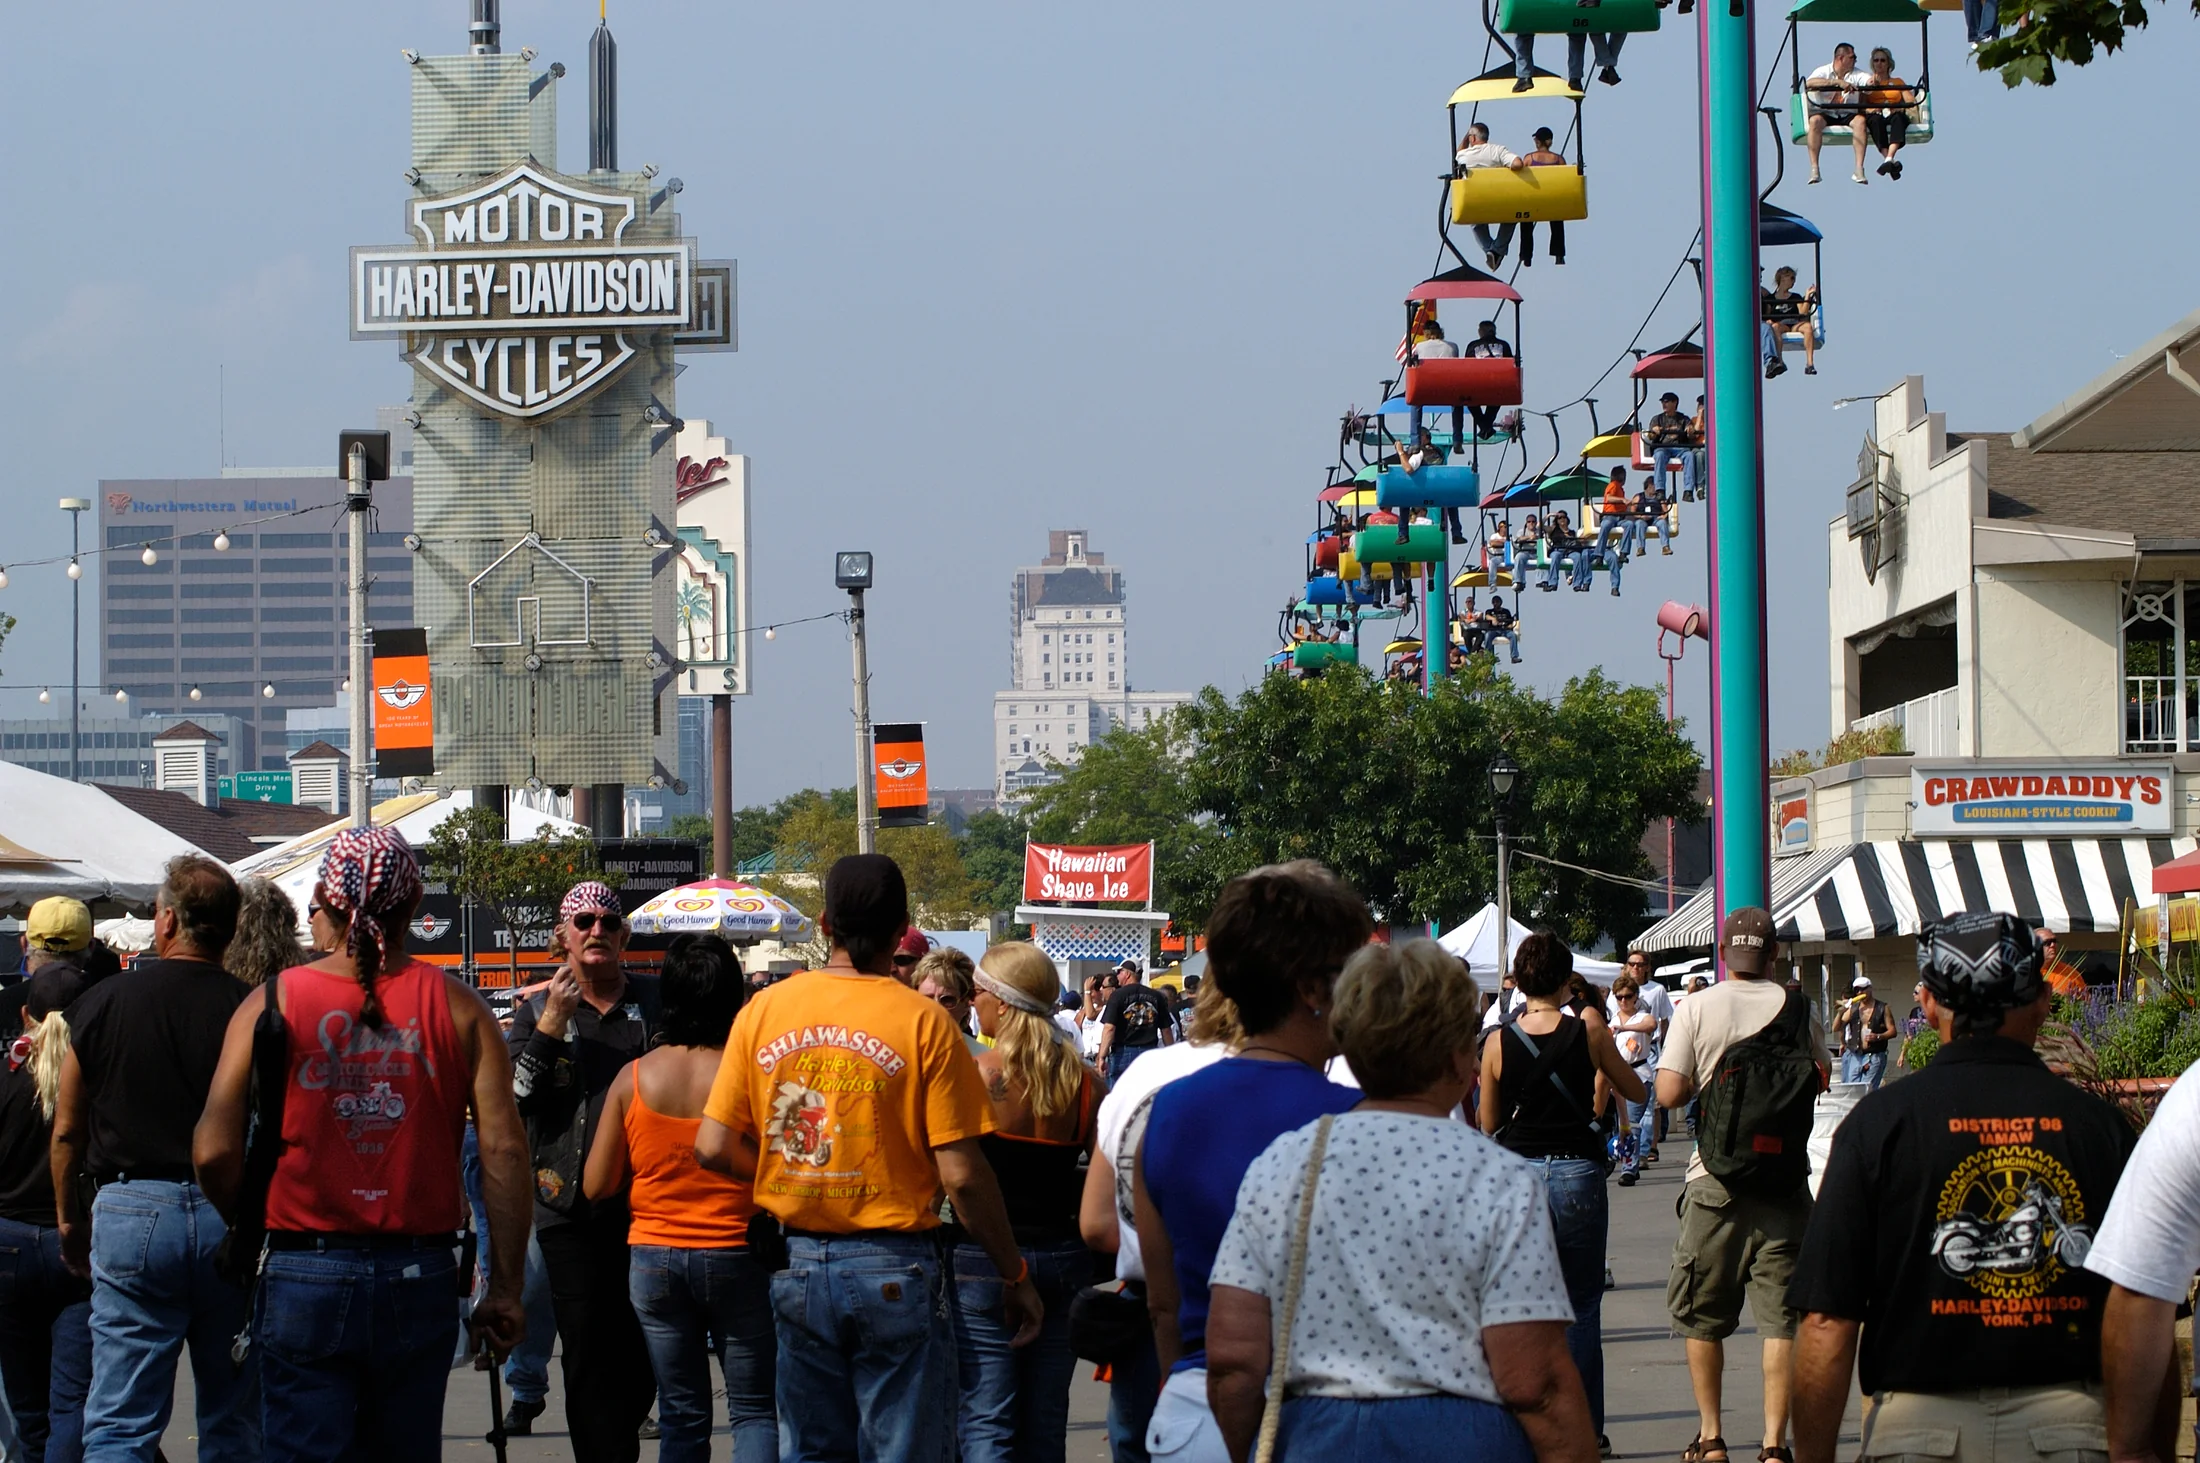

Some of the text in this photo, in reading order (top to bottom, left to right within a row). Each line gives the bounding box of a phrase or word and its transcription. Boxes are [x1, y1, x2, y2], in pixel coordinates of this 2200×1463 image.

[444, 181, 604, 244] MOTOR
[371, 259, 674, 317] HARLEY-DAVIDSON
[443, 335, 602, 406] CYCLES
[133, 499, 297, 513] Northwestern Mutual
[255, 784, 277, 792] Drive
[1924, 775, 2162, 806] CRAWDADDY'S
[1963, 806, 2121, 818] LOUISIANA-STYLE COOKIN'
[605, 860, 693, 874] HARLEY-DAVIDSON
[1048, 848, 1126, 873] Hawaiian
[1040, 873, 1129, 898] Shave Ice
[663, 915, 685, 928] Good
[686, 915, 716, 924] Humor
[727, 914, 747, 926] Good
[748, 915, 775, 925] Humor
[494, 929, 553, 948] TEESC
[1731, 934, 1746, 946] EST.
[756, 1024, 907, 1078] SHIAWASSEE
[794, 1052, 871, 1074] Harley-
[809, 1075, 886, 1093] Davidson
[1949, 1117, 2063, 1133] DISTRICT 98
[1979, 1131, 2035, 1146] IAMAW
[1946, 1166, 1981, 1220] SSOCIATION
[1992, 1156, 2054, 1178] MACHINISTS
[1981, 1313, 2029, 1328] YORK,
